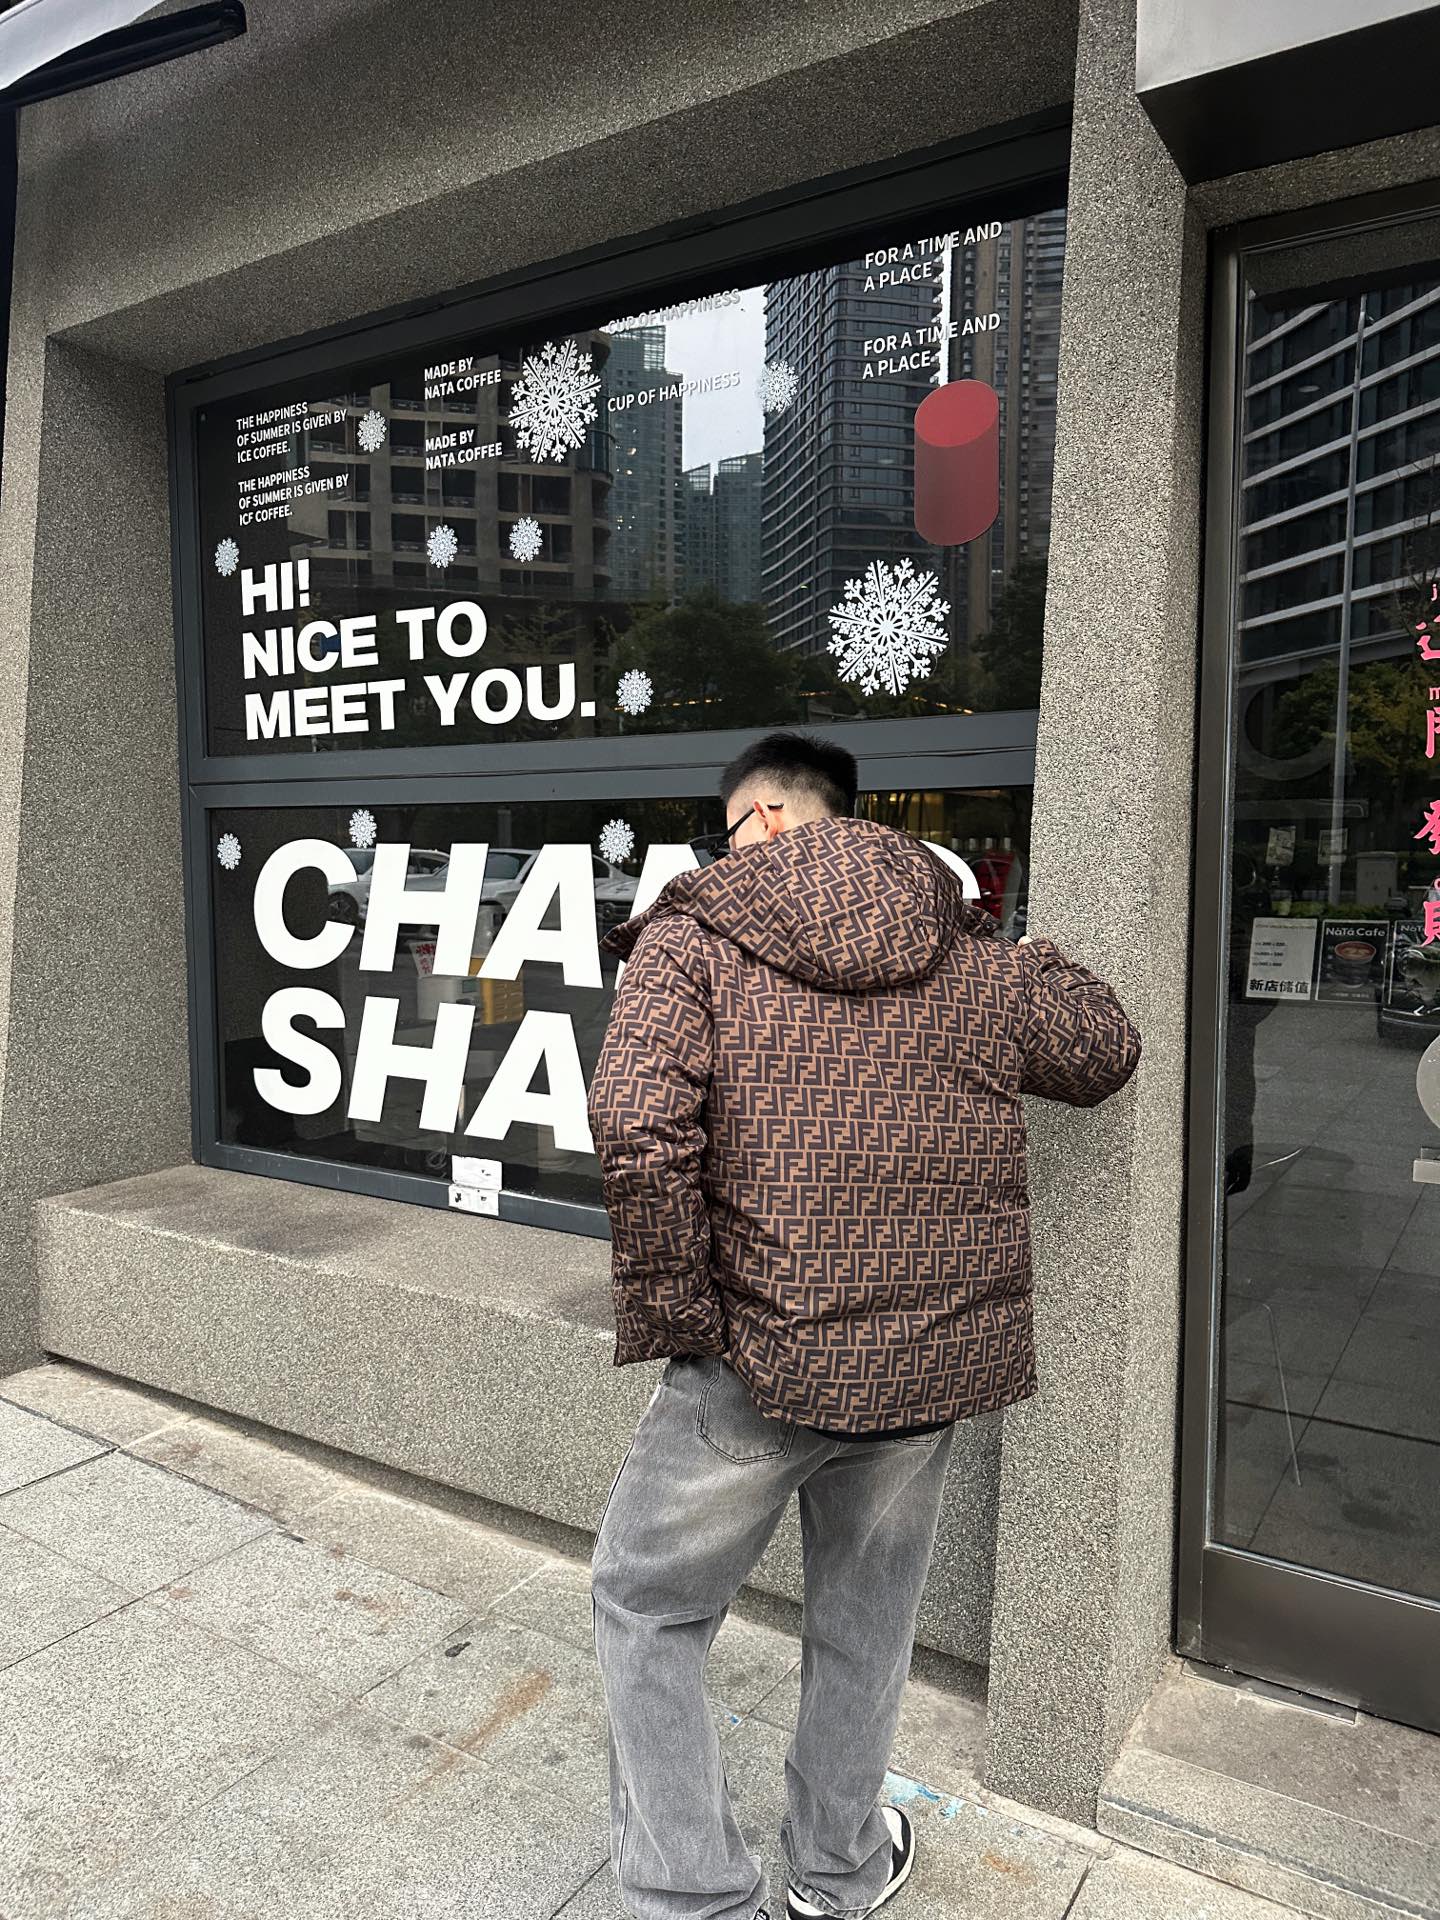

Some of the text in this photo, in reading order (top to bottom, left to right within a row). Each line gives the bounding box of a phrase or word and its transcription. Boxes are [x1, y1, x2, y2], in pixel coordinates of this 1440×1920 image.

[865, 221, 1003, 269] FOR A TIME AND
[863, 261, 932, 292] A PLACE
[607, 288, 741, 334] CUP OF HAPPINESS
[863, 312, 1001, 357] FOR A TIME AND
[424, 356, 474, 381] MADE BY
[862, 350, 931, 380] A PLACE
[424, 369, 502, 400] NATA COFFEE
[607, 370, 741, 412] CUP OF HAPPINESS
[236, 401, 308, 431] THE HAPPINESS
[236, 408, 347, 447] OF SUMMER IS GIVEN BY
[237, 440, 291, 463] ICE COFFEE.
[425, 428, 475, 452] MADE BY
[425, 441, 503, 471] NATA COFFEE
[238, 465, 310, 493] THE HAPPINESS
[238, 473, 349, 510] OF SUMMER IS GIVEN BY
[255, 504, 293, 523] COFFEE.
[240, 558, 310, 616] HI!
[242, 601, 488, 680] NICE TO
[245, 662, 596, 741] MEET YOU.
[1355, 927, 1386, 937] Cafe
[253, 986, 596, 1154] SHA
